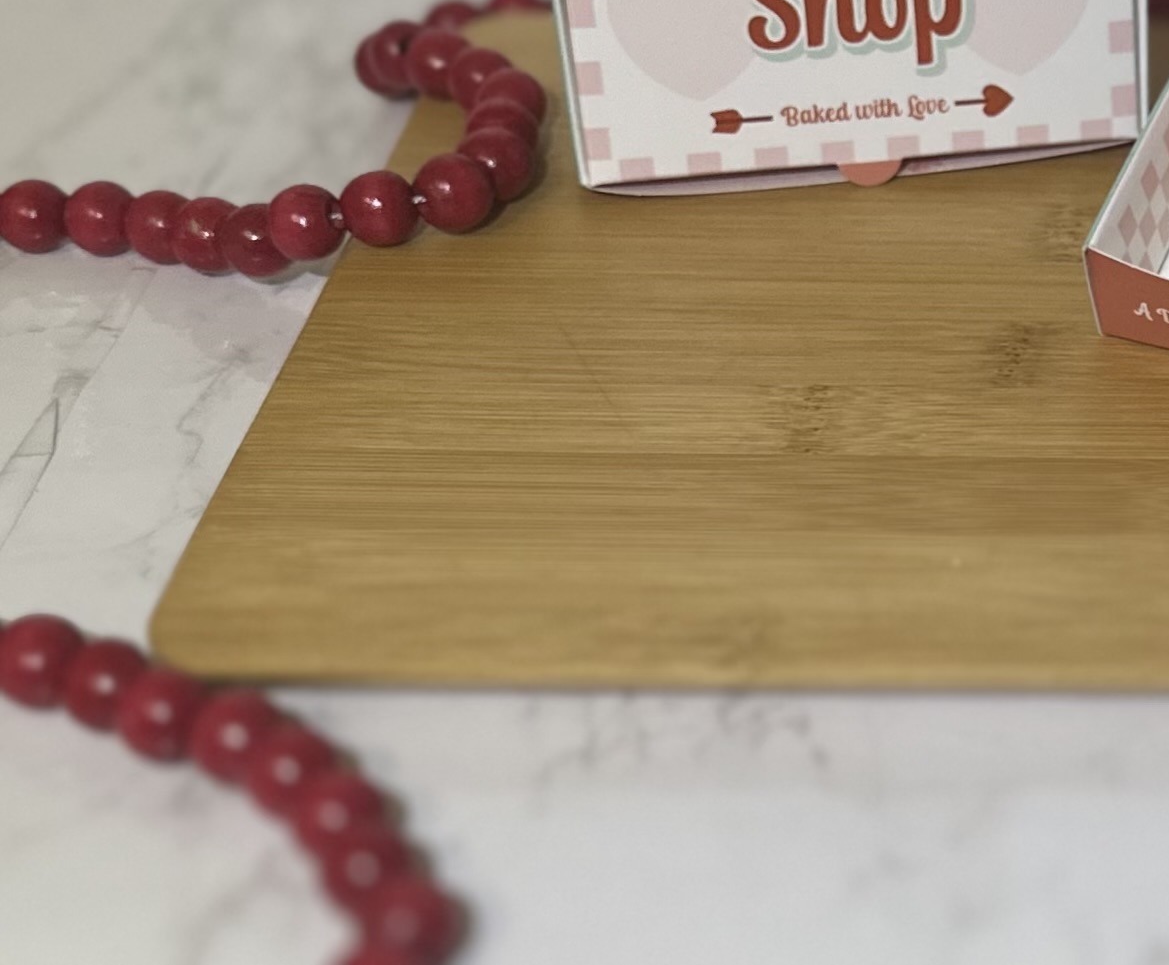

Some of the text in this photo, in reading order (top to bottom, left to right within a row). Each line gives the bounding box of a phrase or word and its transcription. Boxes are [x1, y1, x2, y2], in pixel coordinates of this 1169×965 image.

[780, 94, 949, 127] Baked with Love
[1133, 301, 1154, 322] A
